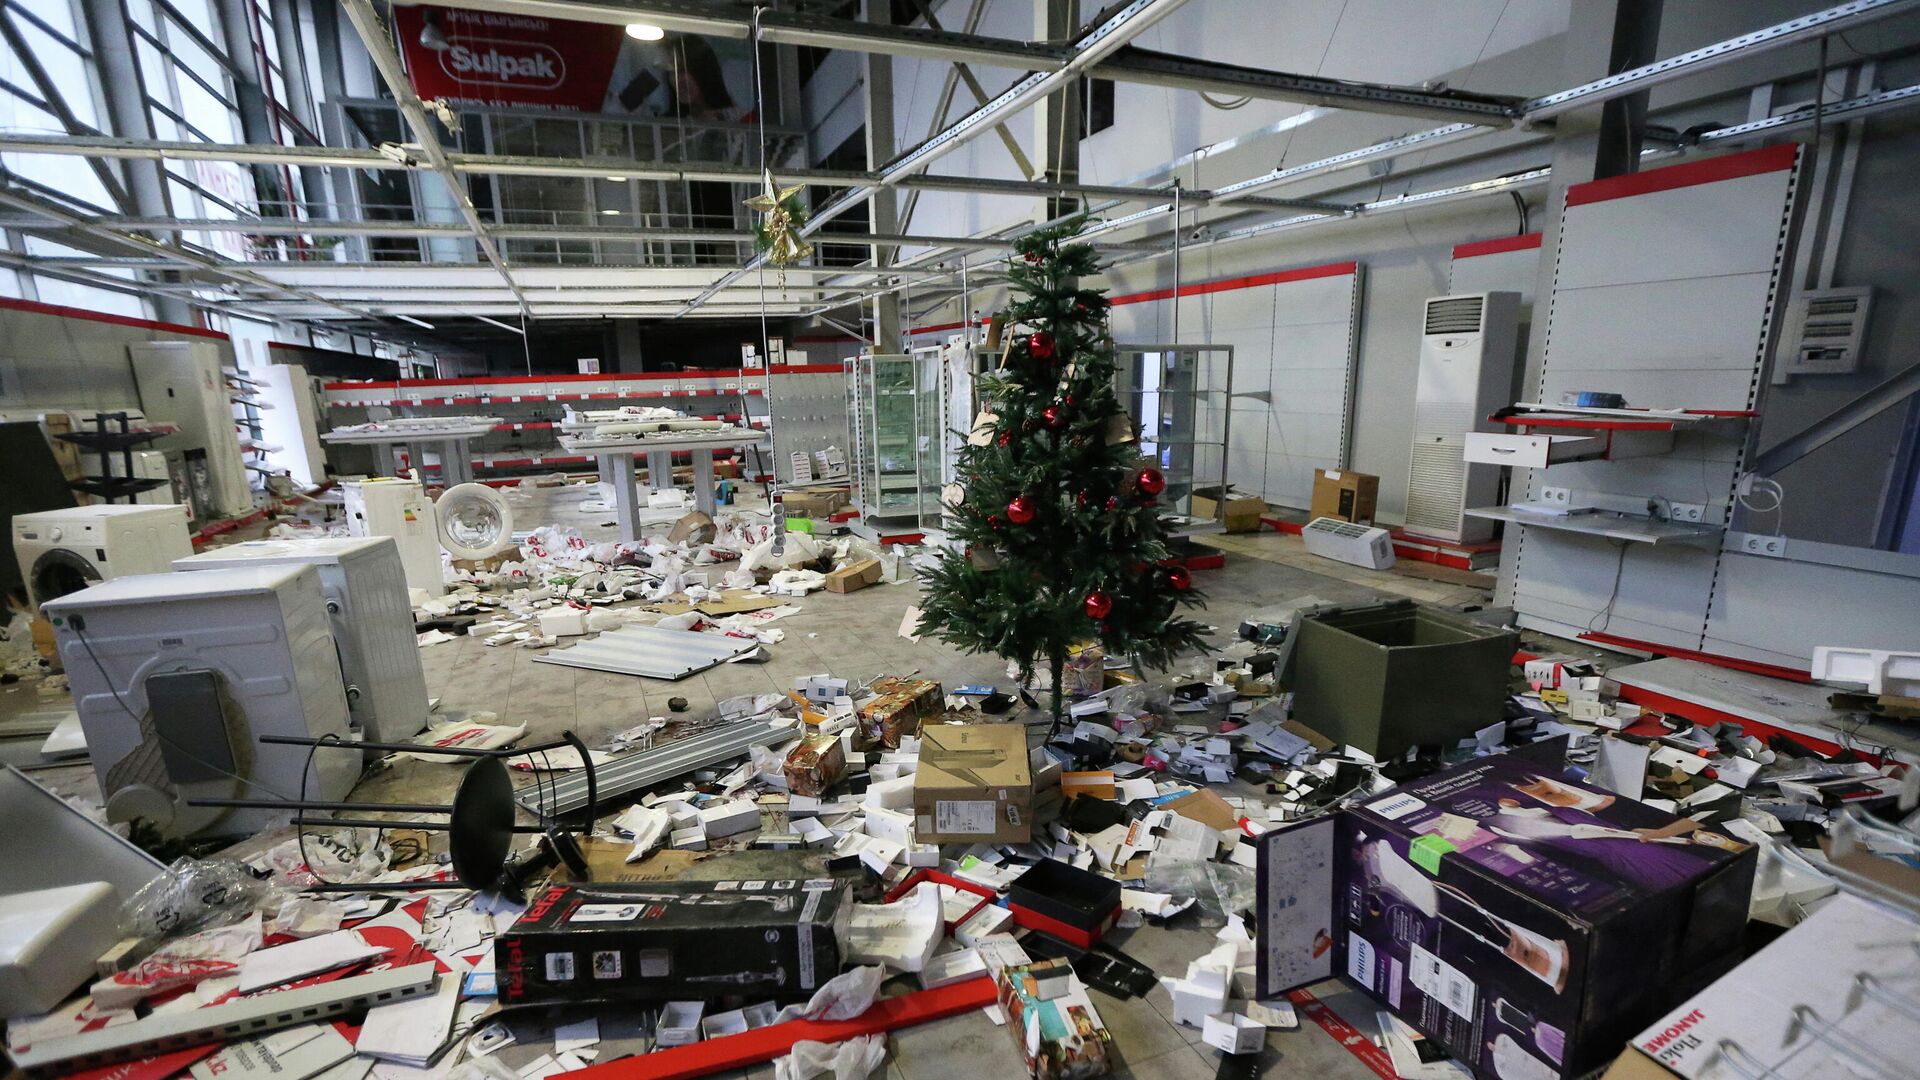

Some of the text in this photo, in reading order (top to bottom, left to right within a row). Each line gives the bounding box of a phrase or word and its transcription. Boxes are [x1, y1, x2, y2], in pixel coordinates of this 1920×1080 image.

[450, 46, 556, 79] Sulpak
[1380, 797, 1416, 813] PHILIPS
[519, 886, 571, 922] Tefal
[507, 939, 525, 998] Tefal
[1357, 941, 1367, 981] PHILIPS
[1644, 1010, 1704, 1053] JANOME
